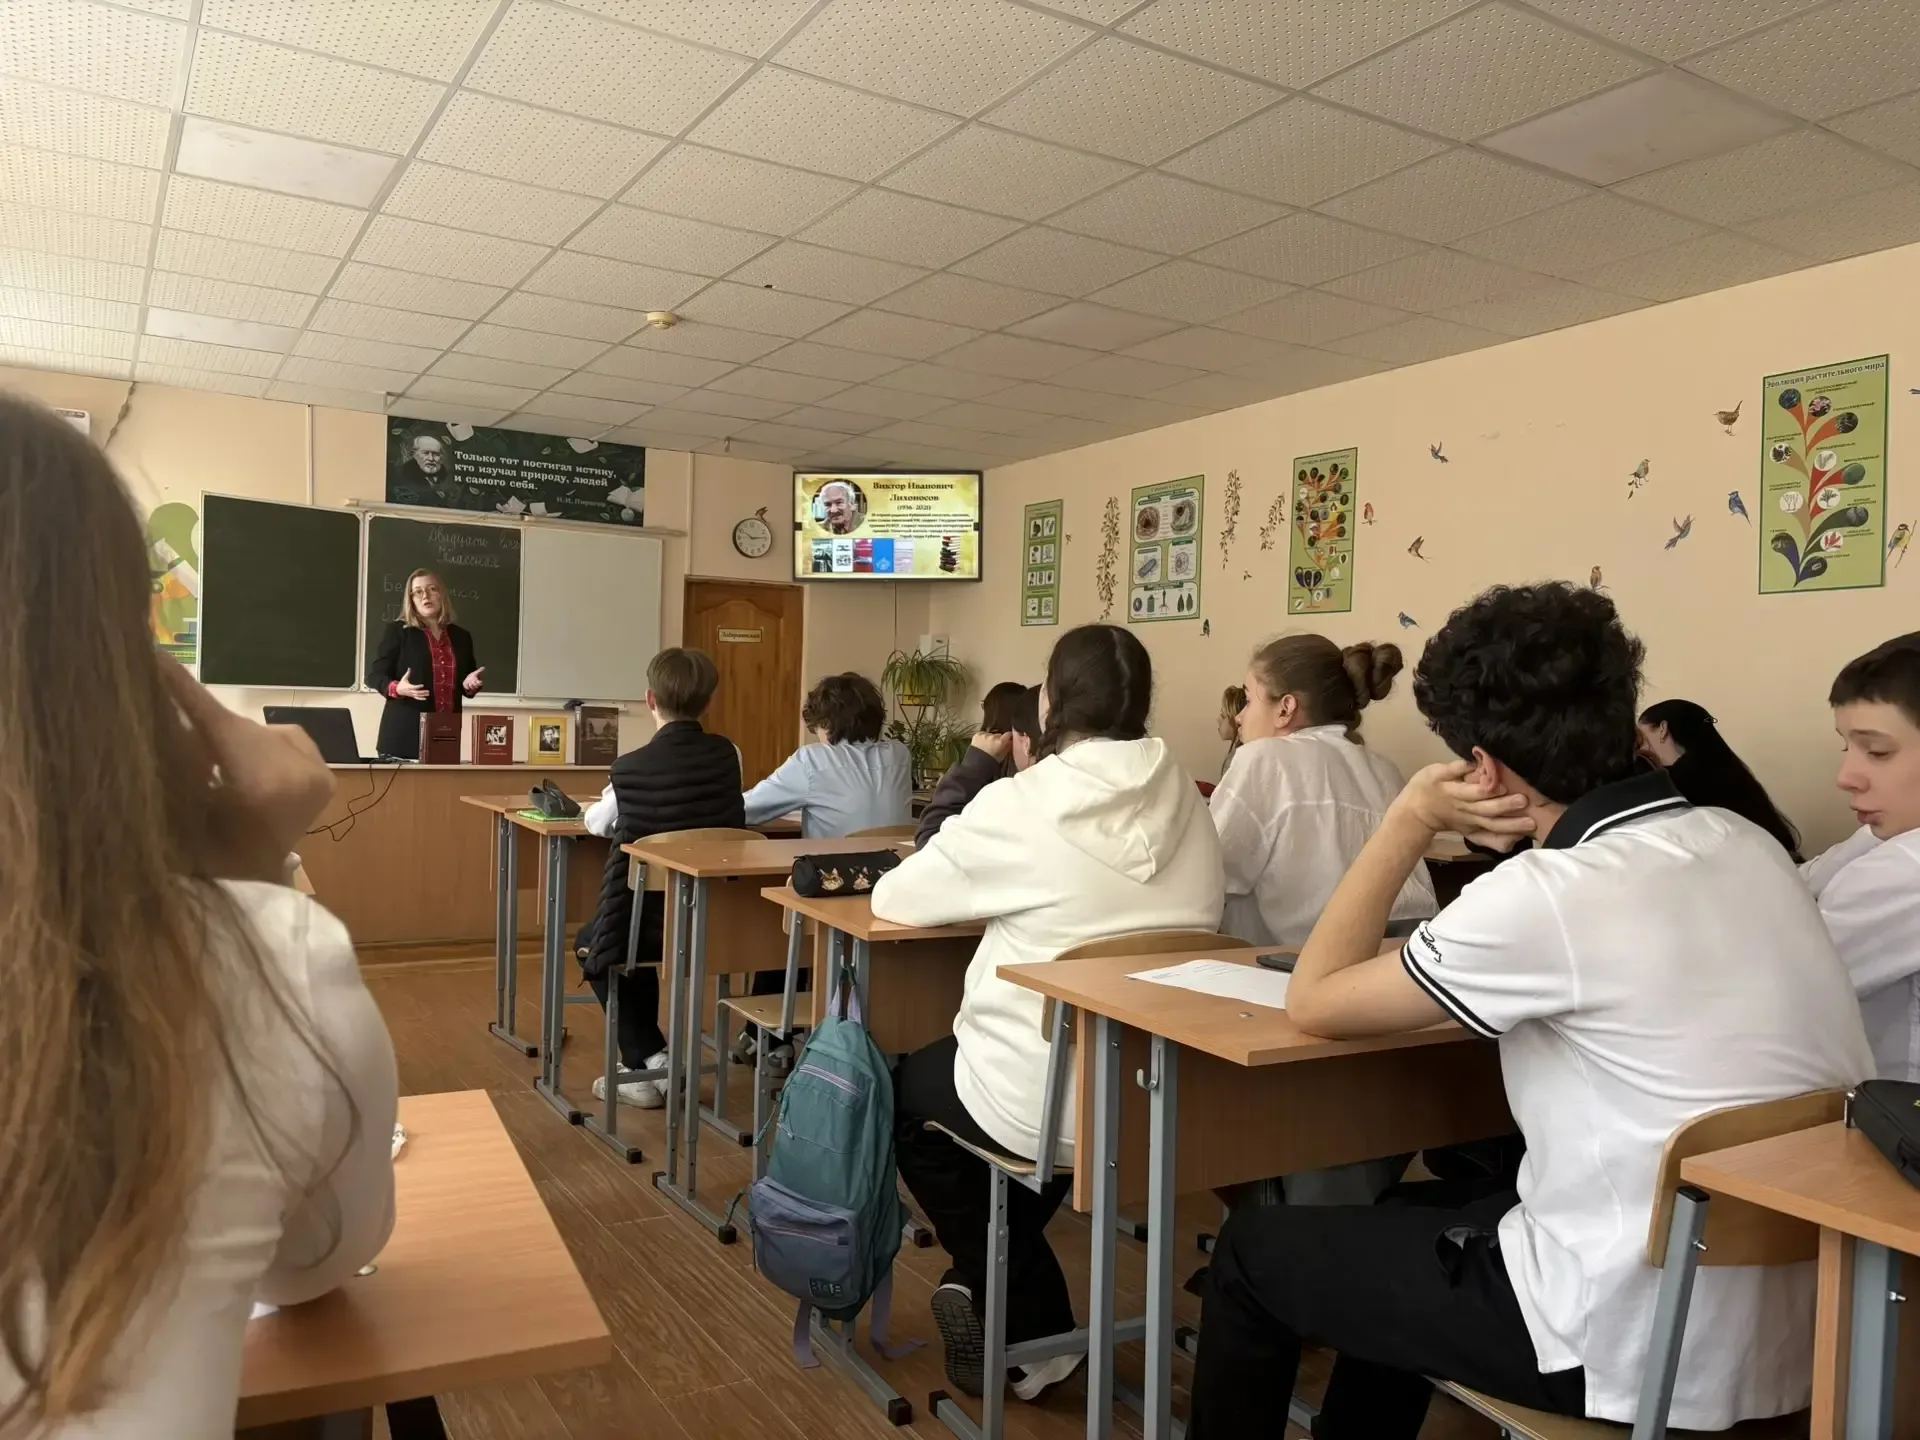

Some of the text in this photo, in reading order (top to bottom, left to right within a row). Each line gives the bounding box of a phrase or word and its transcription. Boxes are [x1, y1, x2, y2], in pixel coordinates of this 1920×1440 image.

[1766, 376, 1805, 388] Эволюция
[1805, 366, 1863, 383] растительного
[1864, 362, 1885, 372] мира
[454, 450, 617, 479] Только тот постигал истину,
[454, 463, 608, 487] кто изучал природу, людей
[454, 474, 538, 491] и самого себя.
[873, 482, 954, 490] Виктор Иванович
[574, 498, 607, 508] Пирогов
[889, 493, 940, 501] Лихоносов
